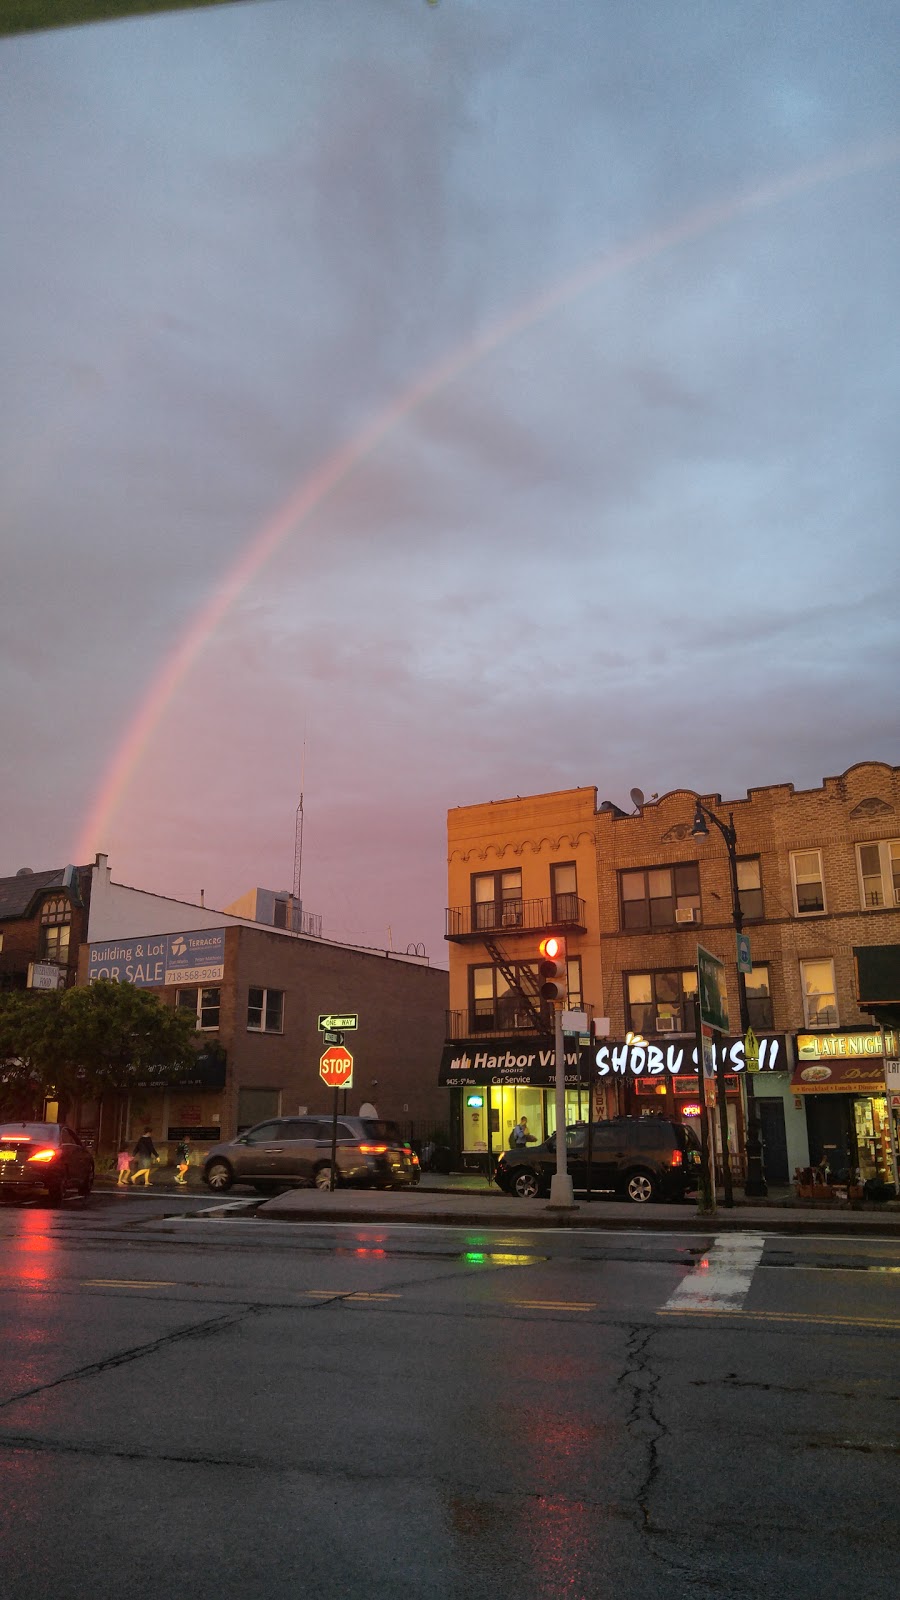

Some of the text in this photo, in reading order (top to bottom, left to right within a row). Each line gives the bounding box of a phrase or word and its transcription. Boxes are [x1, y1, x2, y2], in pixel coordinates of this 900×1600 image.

[91, 943, 164, 962] Building & Lot
[90, 966, 120, 985] FOR
[125, 962, 163, 983] SALE
[167, 968, 222, 982] 718-568-9261
[814, 1033, 893, 1056] LATE NIGHT
[322, 1059, 351, 1074] STOP
[474, 1050, 583, 1069] Harbor Viw
[595, 1044, 684, 1076] SHOBU
[491, 1075, 531, 1084] Car Service
[841, 1068, 885, 1079] Deli
[683, 1106, 701, 1115] OPEN
